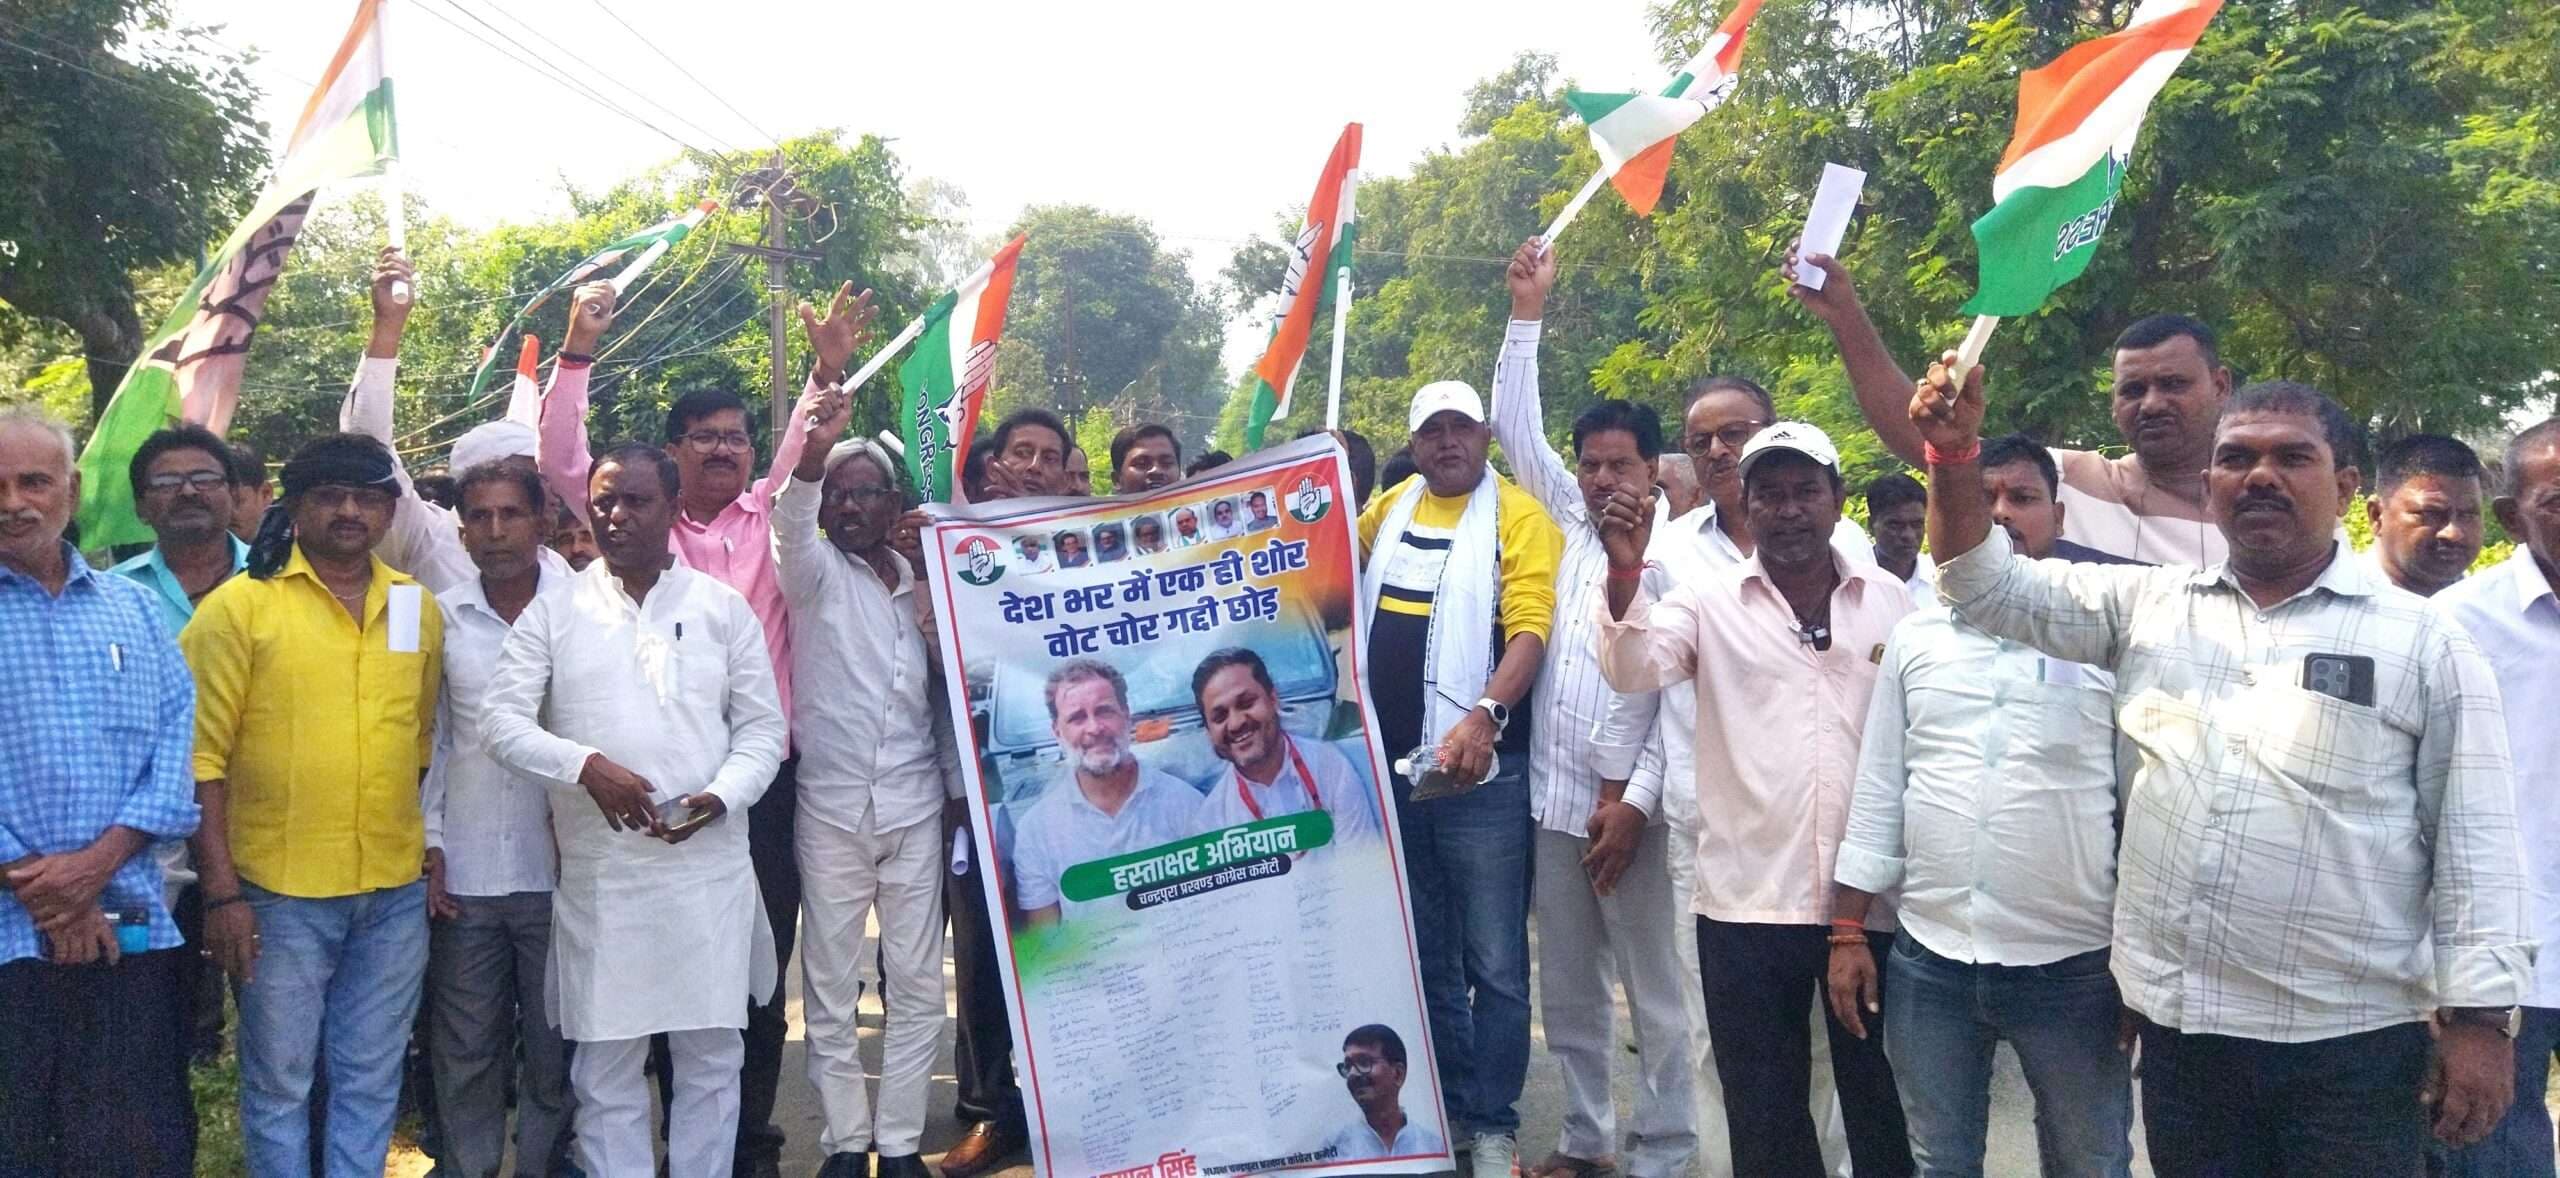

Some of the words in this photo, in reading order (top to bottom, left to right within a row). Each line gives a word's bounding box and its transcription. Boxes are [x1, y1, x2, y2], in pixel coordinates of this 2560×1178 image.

[999, 590, 1055, 625] देश
[1063, 583, 1115, 614] भर
[1119, 568, 1154, 604] में
[1155, 562, 1206, 597] एक
[1209, 550, 1245, 585] ही
[1251, 538, 1307, 576] शोर
[1043, 623, 1099, 658] वोट
[1103, 611, 1159, 647] चोर
[1163, 595, 1220, 633] गद्दी
[1223, 586, 1279, 623] छोड़
[1109, 846, 1200, 891] हस्ताक्षर
[1206, 825, 1297, 866] अभियान
[1137, 884, 1179, 905] चन्द्रपुरा
[1180, 875, 1214, 895] प्रखण्ड
[1215, 866, 1248, 886] कांग्रेस
[1249, 857, 1280, 877] कमेटी
